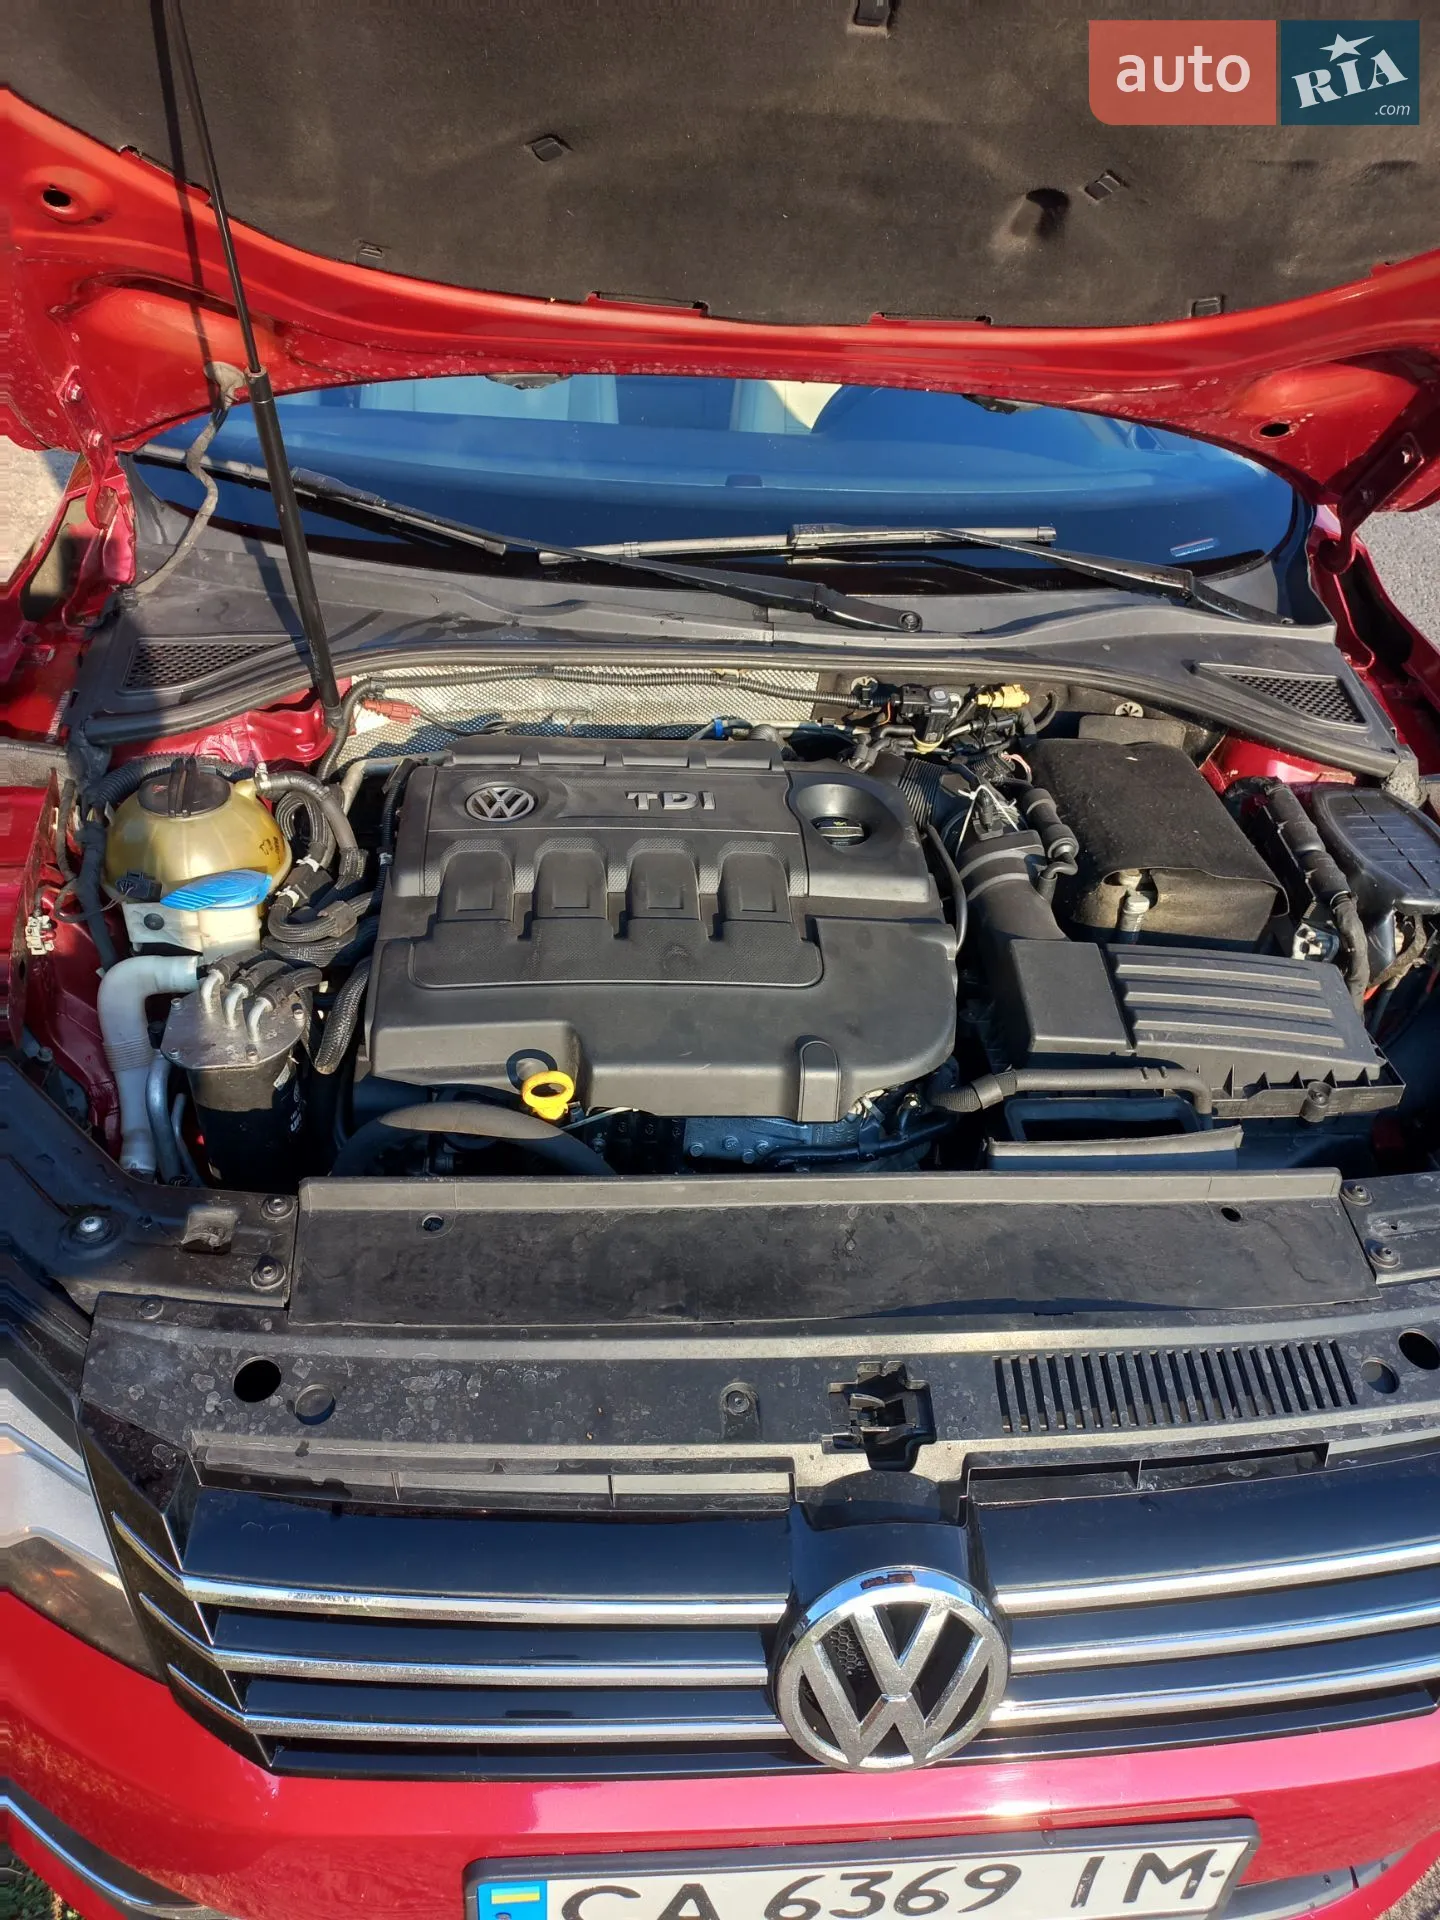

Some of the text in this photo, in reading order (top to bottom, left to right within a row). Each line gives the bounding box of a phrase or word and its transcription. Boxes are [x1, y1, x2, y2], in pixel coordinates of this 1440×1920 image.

[625, 791, 716, 811] TDI
[783, 1595, 1004, 1771] VW
[561, 1848, 1218, 1920] CA 6369 IM
